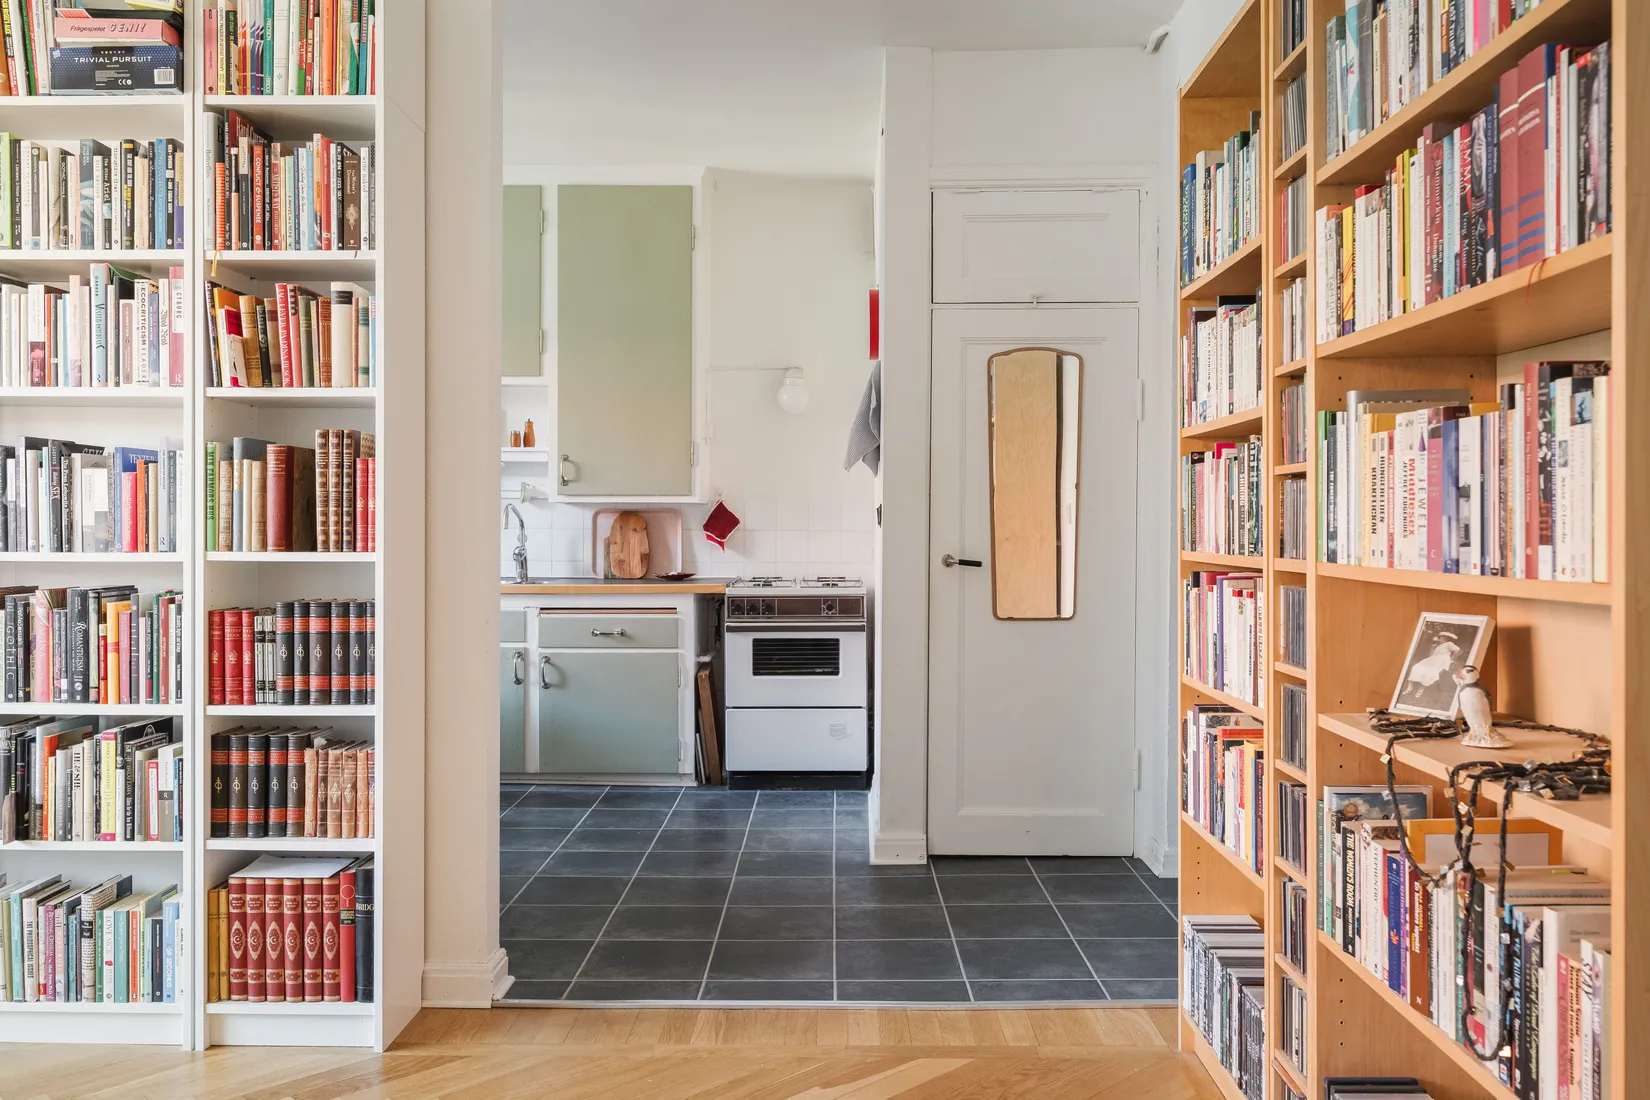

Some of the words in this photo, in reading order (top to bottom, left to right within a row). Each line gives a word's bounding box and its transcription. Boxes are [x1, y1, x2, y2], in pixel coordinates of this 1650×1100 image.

[110, 22, 147, 32] GENI!
[1461, 211, 1470, 235] Frog
[1431, 233, 1439, 272] Donoghue
[1462, 239, 1470, 268] Music
[289, 286, 298, 316] TITO
[279, 304, 287, 328] LEVER
[281, 340, 289, 359] DINA
[51, 486, 60, 500] SEX
[1408, 458, 1416, 536] Middlesex
[1418, 477, 1426, 532] JEWEL
[6, 626, 15, 680] GOTHIC
[75, 621, 87, 671] ROMANTICISM
[74, 752, 80, 765] HE
[1346, 833, 1355, 849] THE
[1346, 850, 1355, 884] WOMEN'S
[1346, 884, 1355, 907] ROOM
[1414, 881, 1420, 892] En
[1530, 968, 1539, 991] Lake
[1581, 959, 1593, 1002] STAY
[1529, 992, 1539, 1000] of
